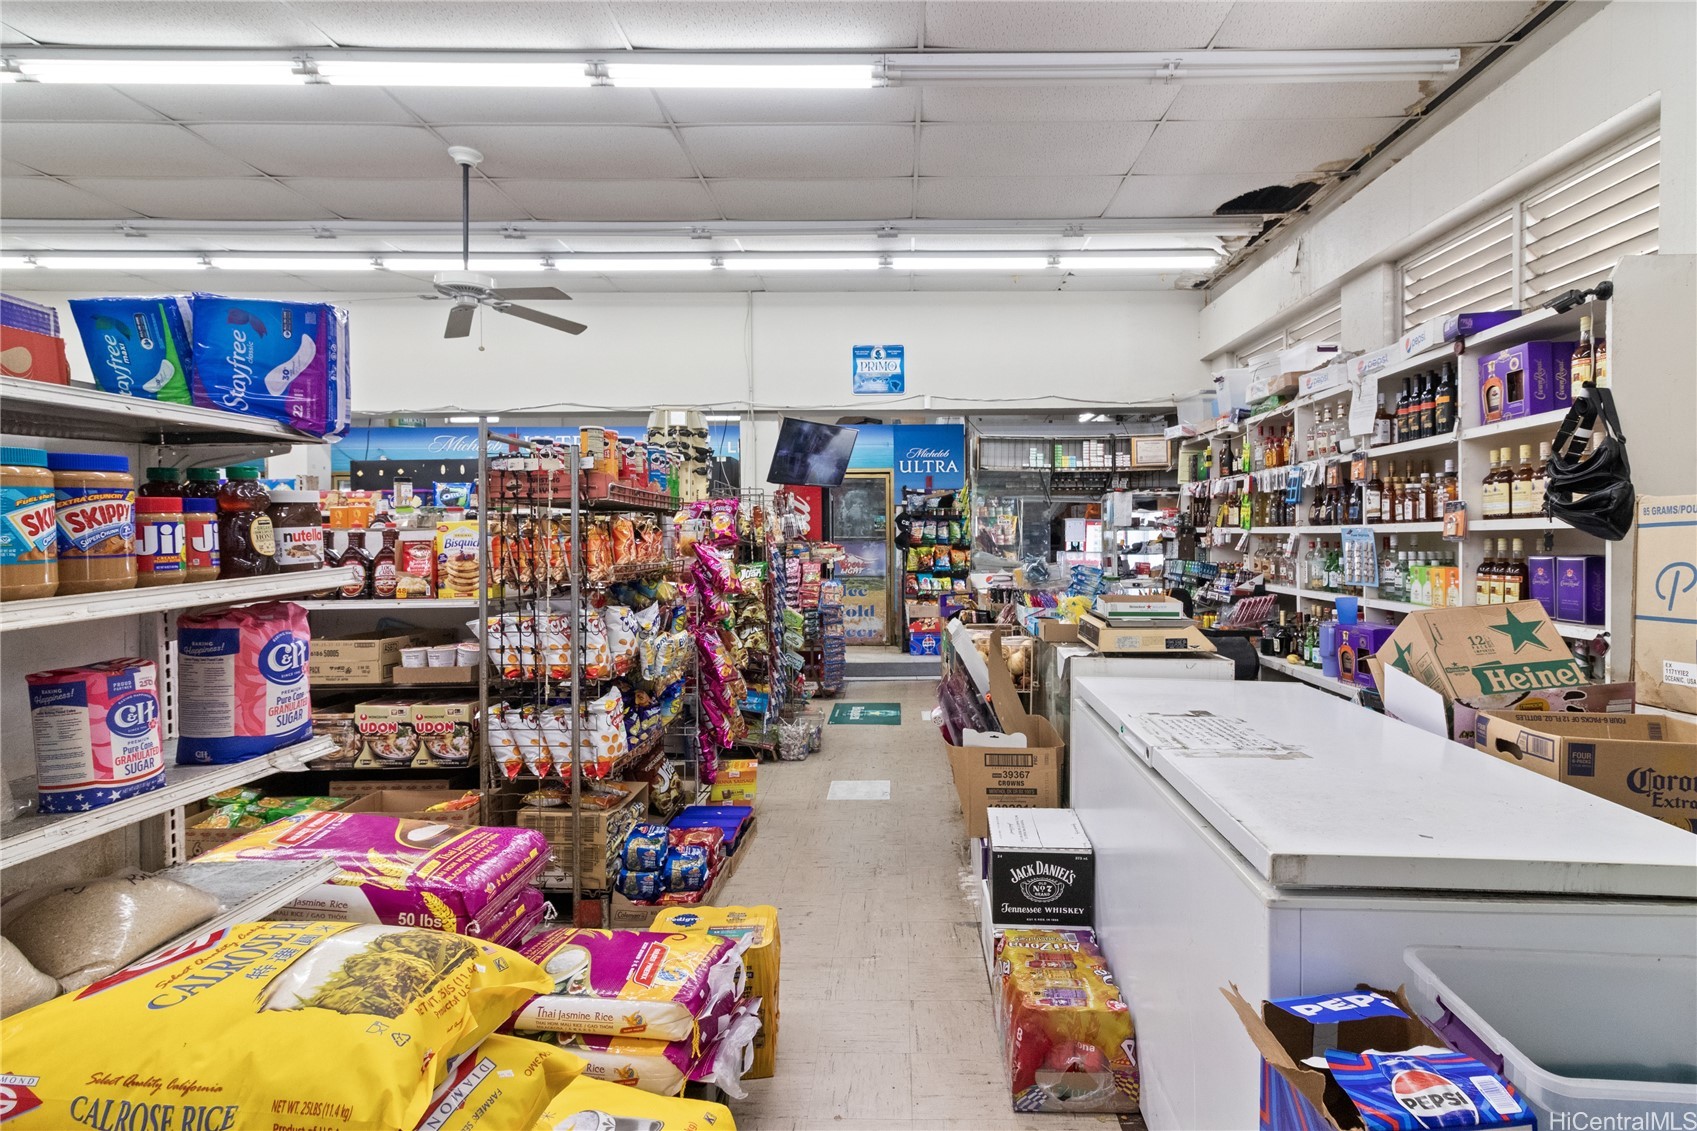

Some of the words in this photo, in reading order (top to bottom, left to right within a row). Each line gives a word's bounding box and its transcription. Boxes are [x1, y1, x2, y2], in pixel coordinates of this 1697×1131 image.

[119, 341, 130, 364] maxi
[104, 334, 134, 396] tayfree
[222, 329, 253, 411] Stayfree
[293, 404, 303, 418] 22
[906, 447, 950, 459] Michelob
[899, 459, 959, 473] ULTRA
[56, 497, 88, 509] EXTRA
[88, 493, 123, 502] CRUNCHY
[65, 503, 129, 533] SKIPPY
[80, 534, 101, 548] SUPER
[283, 528, 322, 542] nutella
[845, 604, 875, 617] old
[845, 629, 877, 637] eer
[1467, 635, 1485, 646] 12
[267, 640, 306, 672] C&H
[276, 694, 292, 705] Pure
[293, 691, 305, 701] Cane
[113, 699, 154, 727] C&H
[268, 697, 307, 717] GRANULATED
[276, 708, 303, 728] SUGAR
[359, 721, 398, 733] UDON
[415, 721, 455, 733] UDON
[114, 746, 158, 765] GRANULATED
[122, 743, 138, 755] Pure
[139, 741, 152, 750] Cane
[1572, 751, 1592, 760] FOUR
[124, 756, 154, 775] SUGAR
[1002, 770, 1030, 779] 39367
[1010, 864, 1034, 884] JACK
[1035, 860, 1076, 886] DANIEL'S
[293, 897, 326, 908] Jasmine
[329, 899, 348, 909] Rice
[1001, 902, 1042, 914] Tennessee
[398, 912, 415, 926] 50
[419, 913, 443, 928] lbs
[147, 932, 298, 1010] CALROSE
[155, 966, 191, 989] Select
[537, 1006, 556, 1018] Thai
[558, 1009, 590, 1021] Jasmine
[594, 1011, 614, 1022] Rice
[586, 1063, 605, 1074] Rice
[86, 1071, 120, 1085] Select
[122, 1074, 162, 1096] Quality
[167, 1078, 223, 1097] California
[271, 1099, 287, 1113] NET
[287, 1100, 300, 1114] WT.
[1401, 1090, 1468, 1111] PEPSI
[69, 1095, 175, 1131] CALROSE
[181, 1105, 239, 1131] RICE
